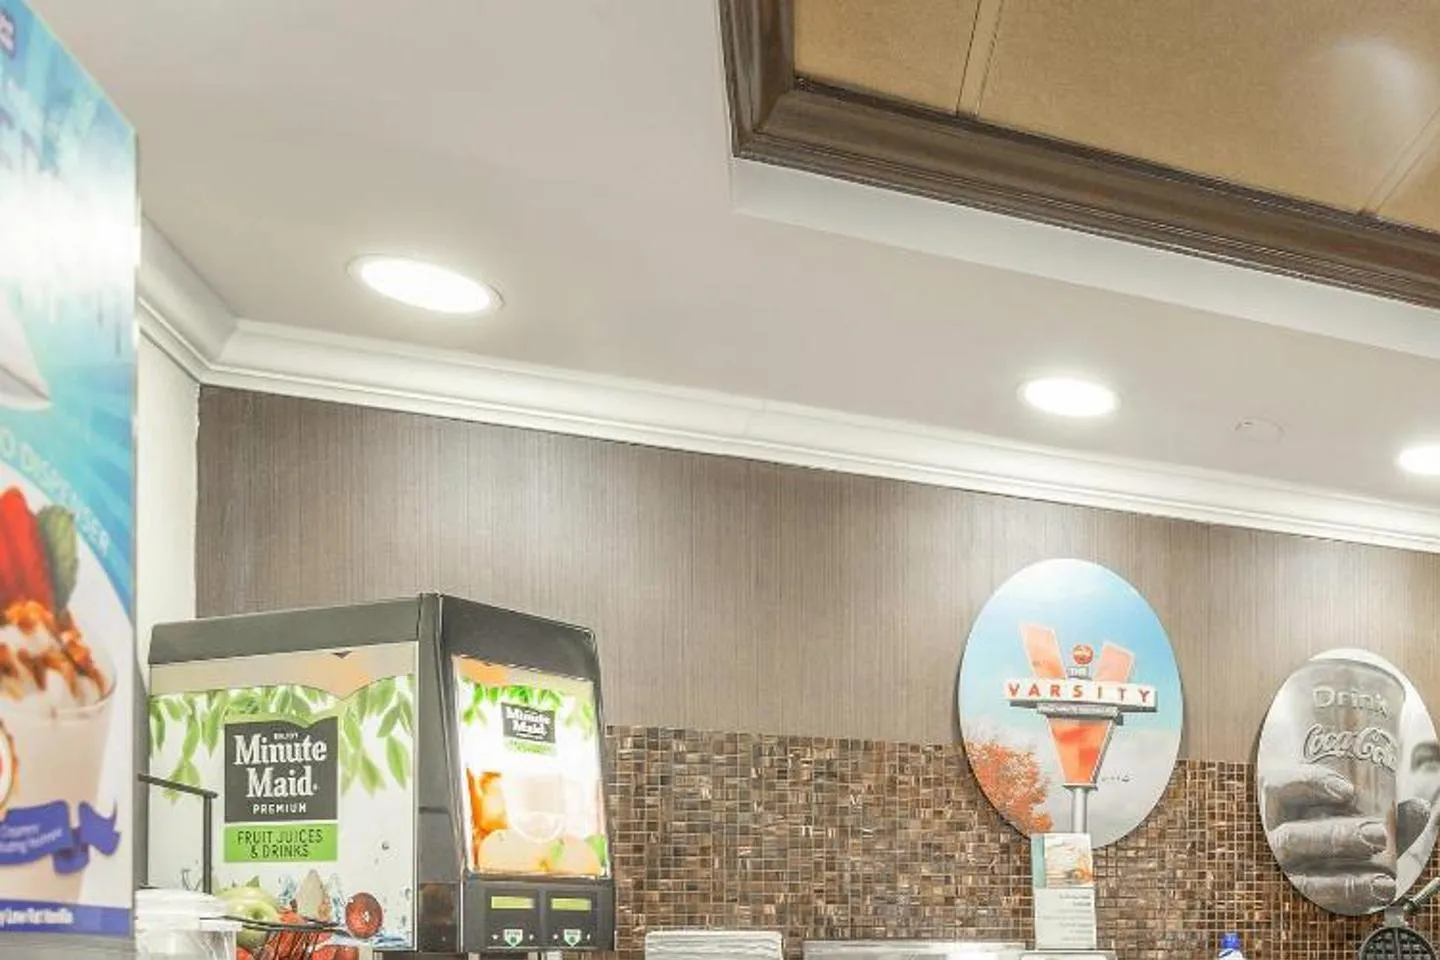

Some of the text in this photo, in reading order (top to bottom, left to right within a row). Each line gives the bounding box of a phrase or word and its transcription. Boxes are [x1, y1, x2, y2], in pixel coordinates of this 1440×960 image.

[1008, 683, 1150, 702] VARSITY
[233, 732, 327, 766] Minute
[246, 765, 315, 798] Maid
[253, 803, 307, 815] PREMIUM
[237, 829, 324, 846] FRUIT JUICES
[262, 844, 310, 859] DRINKS
